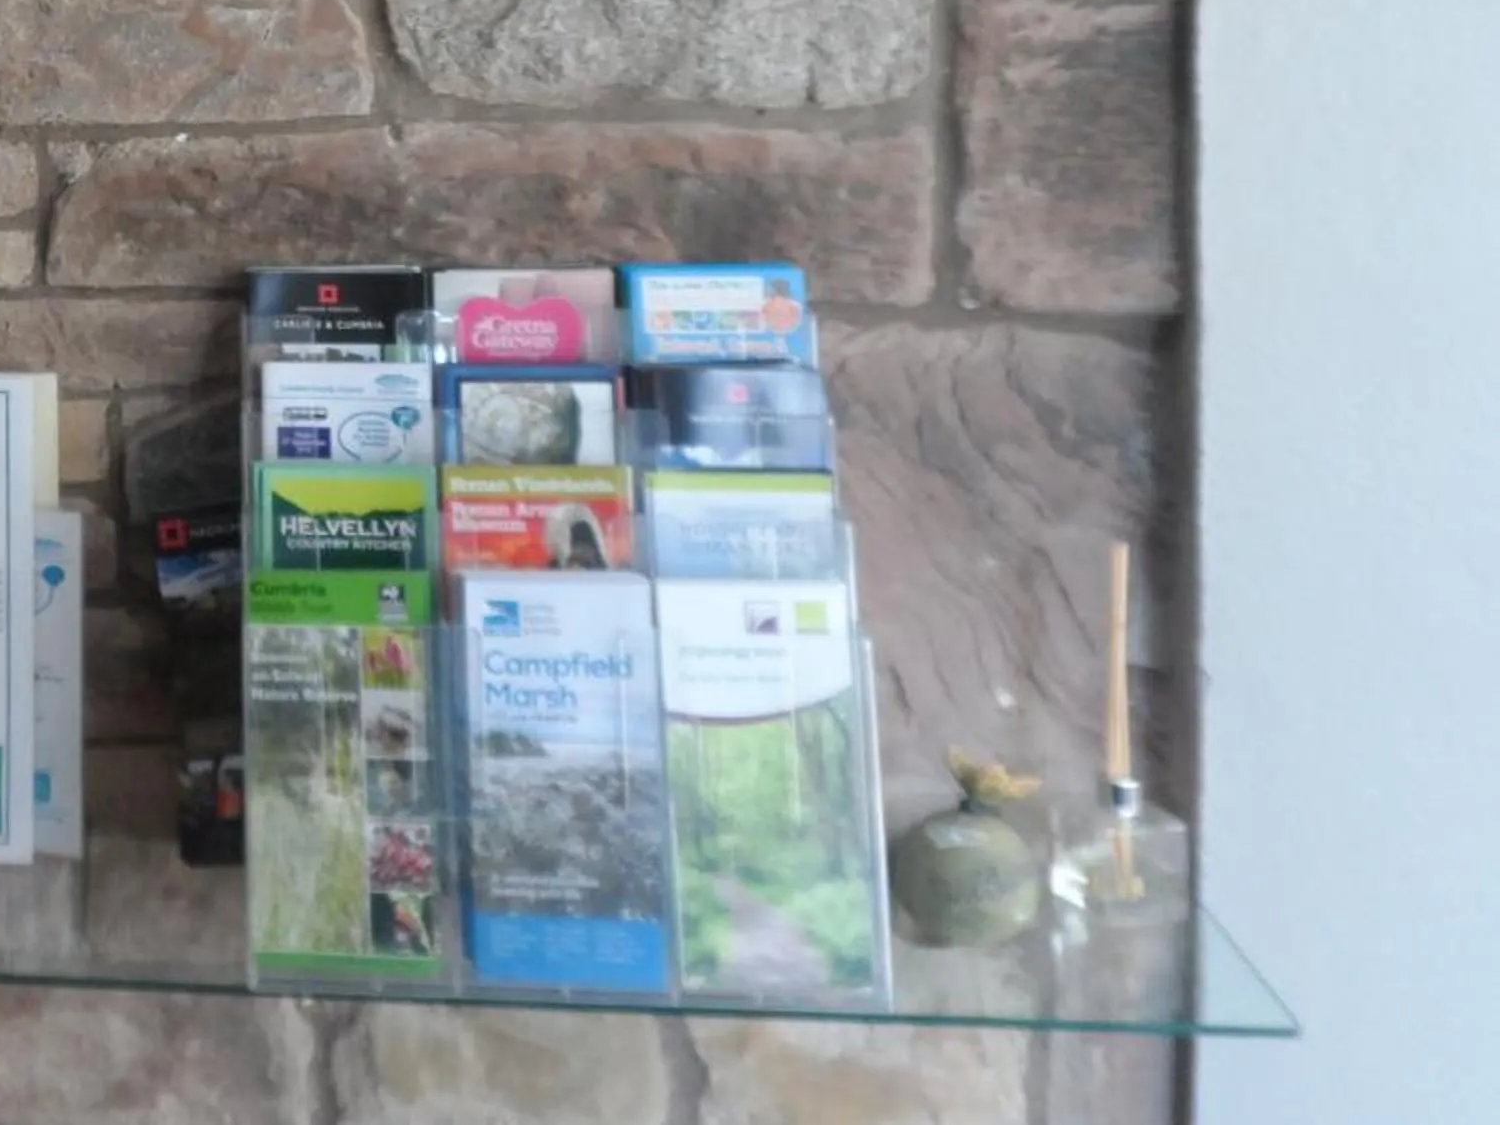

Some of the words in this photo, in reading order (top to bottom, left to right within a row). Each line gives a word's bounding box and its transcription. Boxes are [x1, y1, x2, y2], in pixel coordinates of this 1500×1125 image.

[280, 515, 417, 537] HELVELLYN
[286, 537, 350, 551] COUNTRY
[352, 537, 412, 552] KITCHEN
[250, 581, 327, 597] Cumbria
[483, 650, 634, 683] Campfield
[484, 682, 579, 708] Marsh
